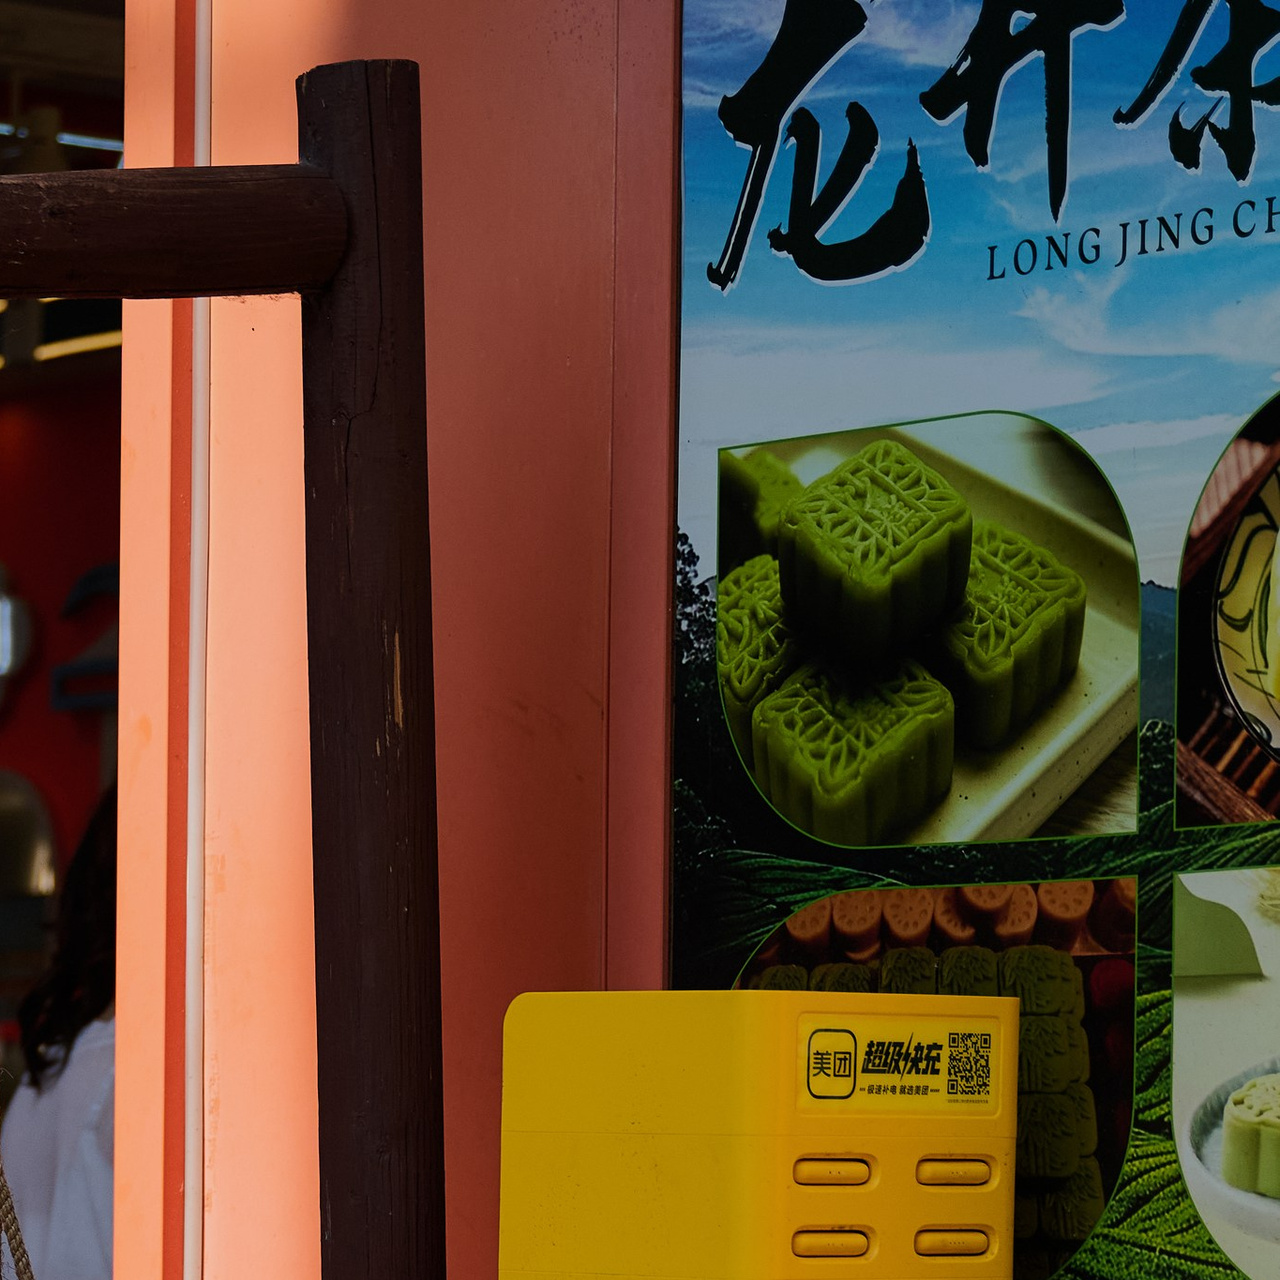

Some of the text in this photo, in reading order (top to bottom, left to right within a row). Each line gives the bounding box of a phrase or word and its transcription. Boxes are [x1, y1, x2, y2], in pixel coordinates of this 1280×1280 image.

[987, 228, 1102, 281] LONG
[1114, 207, 1214, 267] JING
[812, 1050, 852, 1078] 美团
[861, 1039, 943, 1076] 超级快充
[867, 1085, 929, 1096] 极速补电 就选美团
